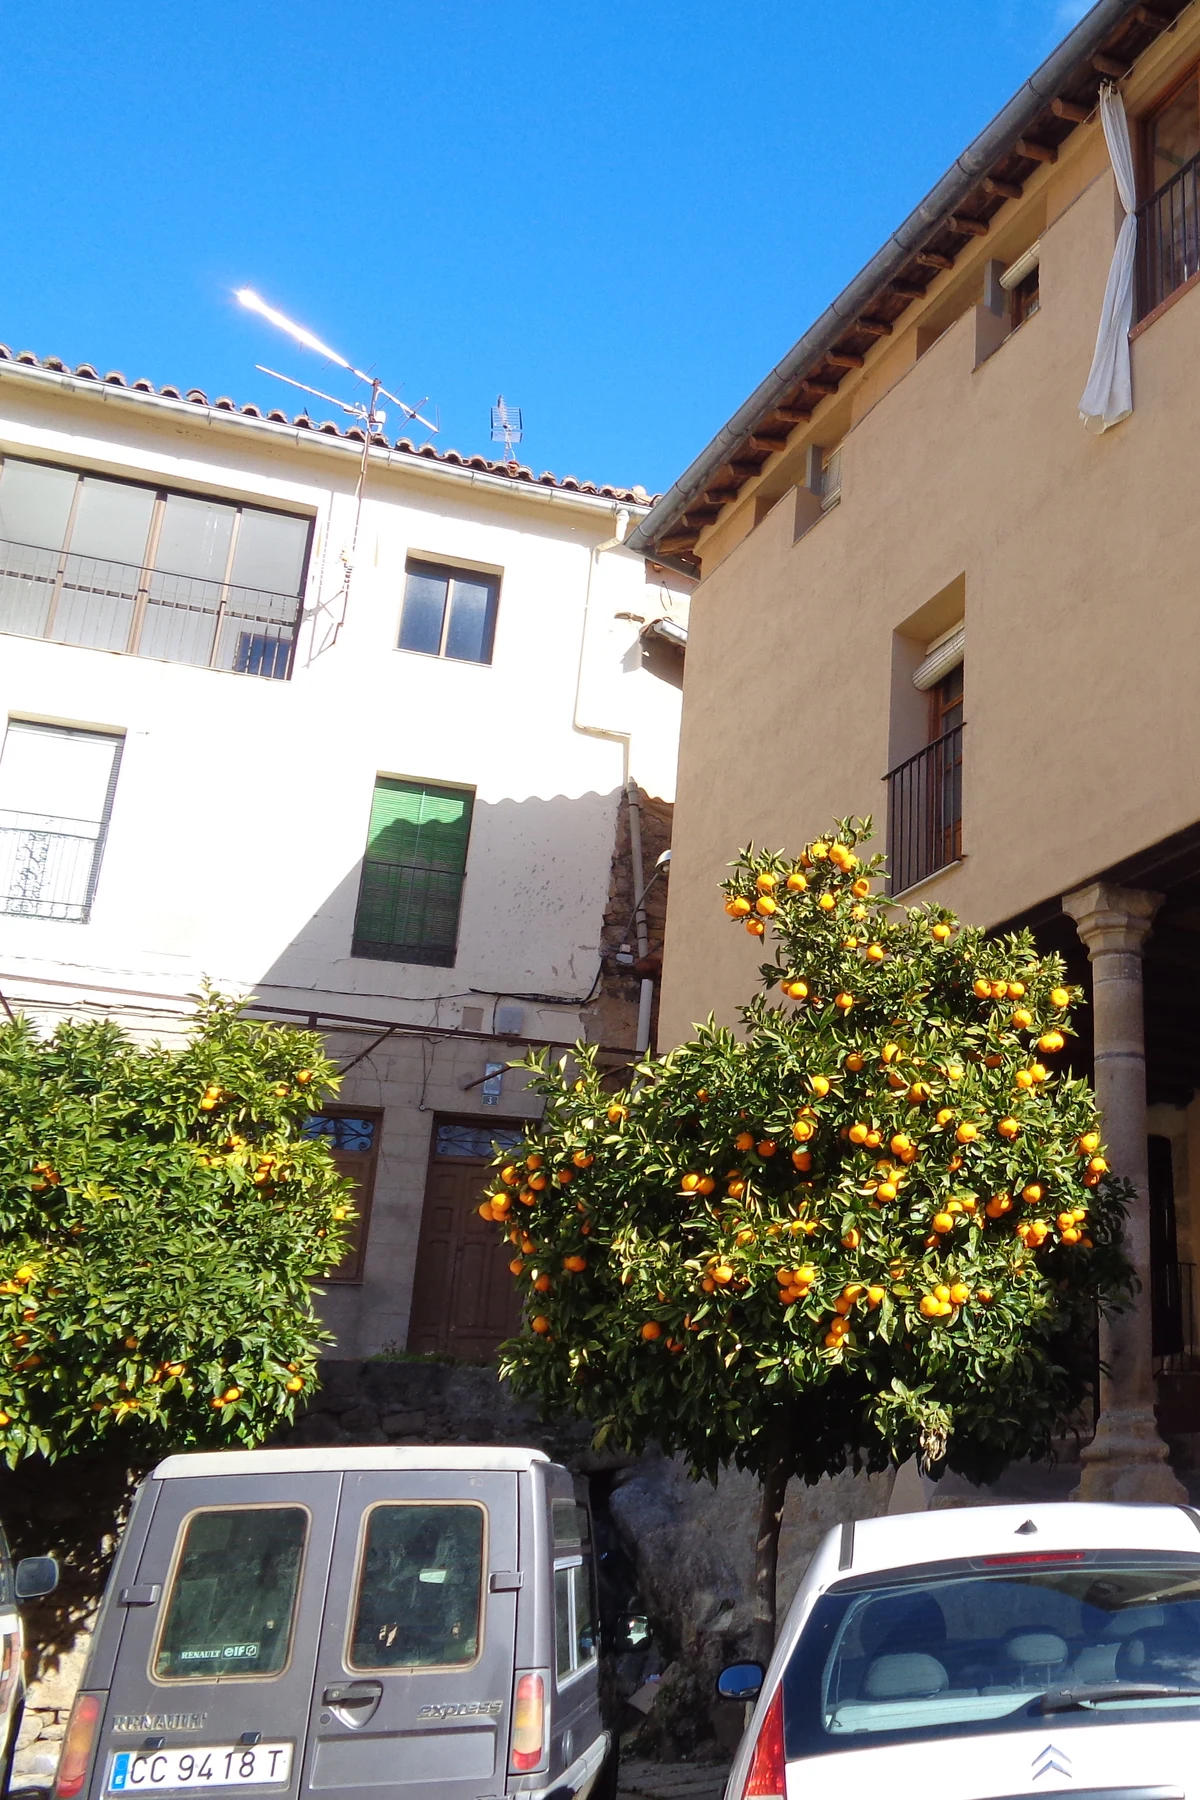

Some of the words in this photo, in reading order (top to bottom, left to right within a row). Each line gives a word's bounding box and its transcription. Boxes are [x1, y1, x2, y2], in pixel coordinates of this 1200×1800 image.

[487, 1096, 492, 1105] 3
[181, 1650, 220, 1660] RENAULT
[224, 1645, 245, 1657] elf
[416, 1700, 503, 1720] express
[112, 1713, 208, 1734] RENAULT
[130, 1756, 168, 1784] CC
[178, 1751, 256, 1781] 9418
[268, 1750, 283, 1778] T
[115, 1775, 123, 1785] E
